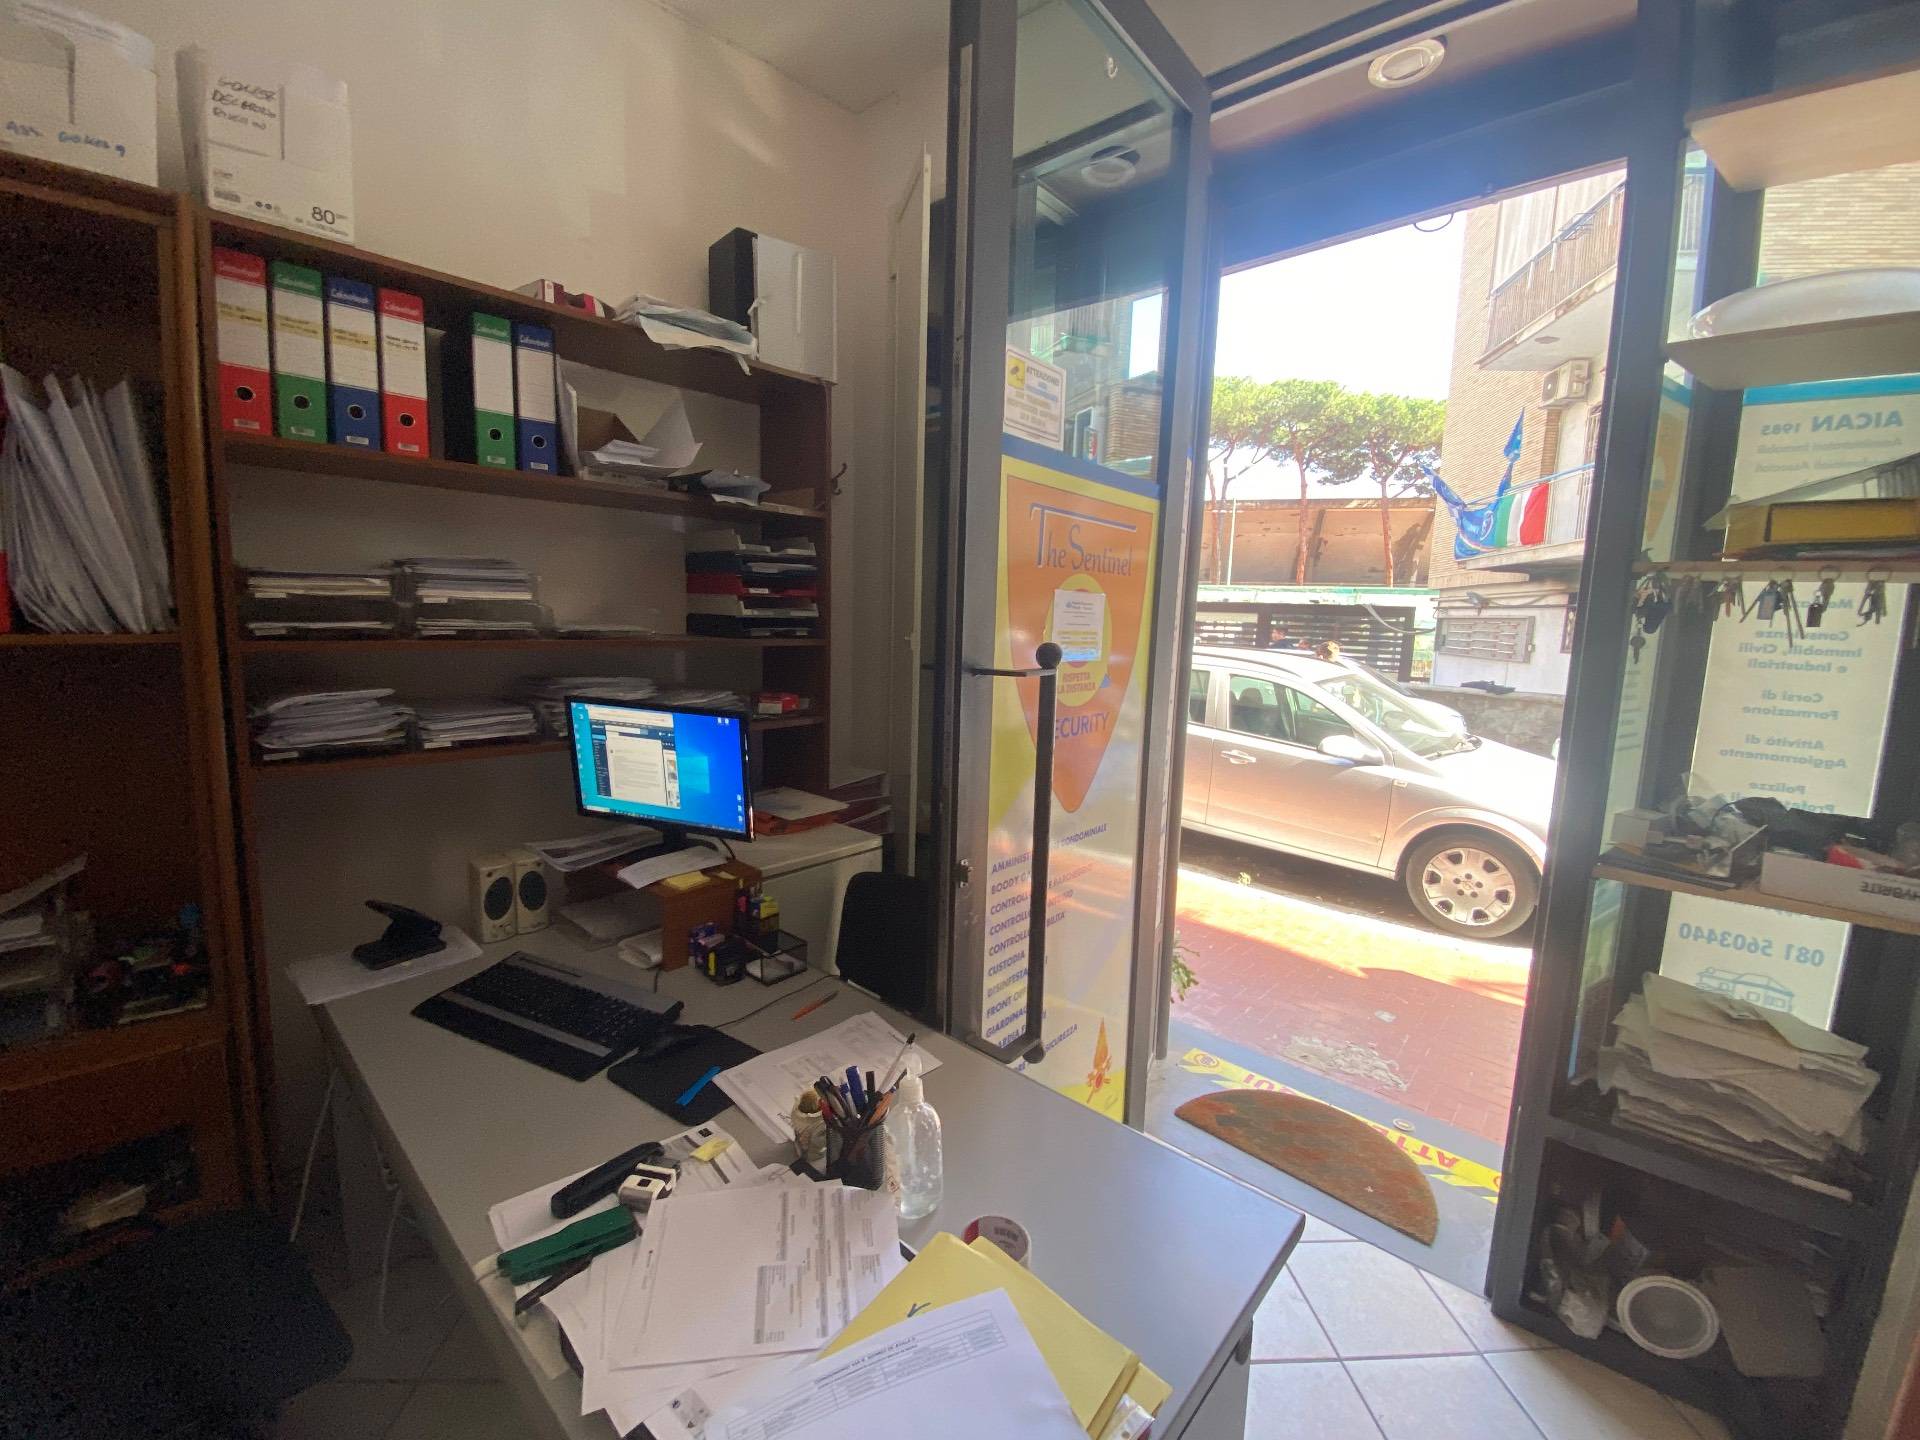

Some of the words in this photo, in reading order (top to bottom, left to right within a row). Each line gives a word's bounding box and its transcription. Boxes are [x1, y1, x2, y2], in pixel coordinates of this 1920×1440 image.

[311, 206, 336, 225] 80
[1029, 503, 1066, 568] The
[1068, 524, 1132, 576] Sentinel
[1055, 712, 1109, 738] ECURITY
[990, 892, 1031, 915] CONTROLL
[987, 951, 1025, 977] CUSTODIA
[986, 995, 1013, 1019] FRONT
